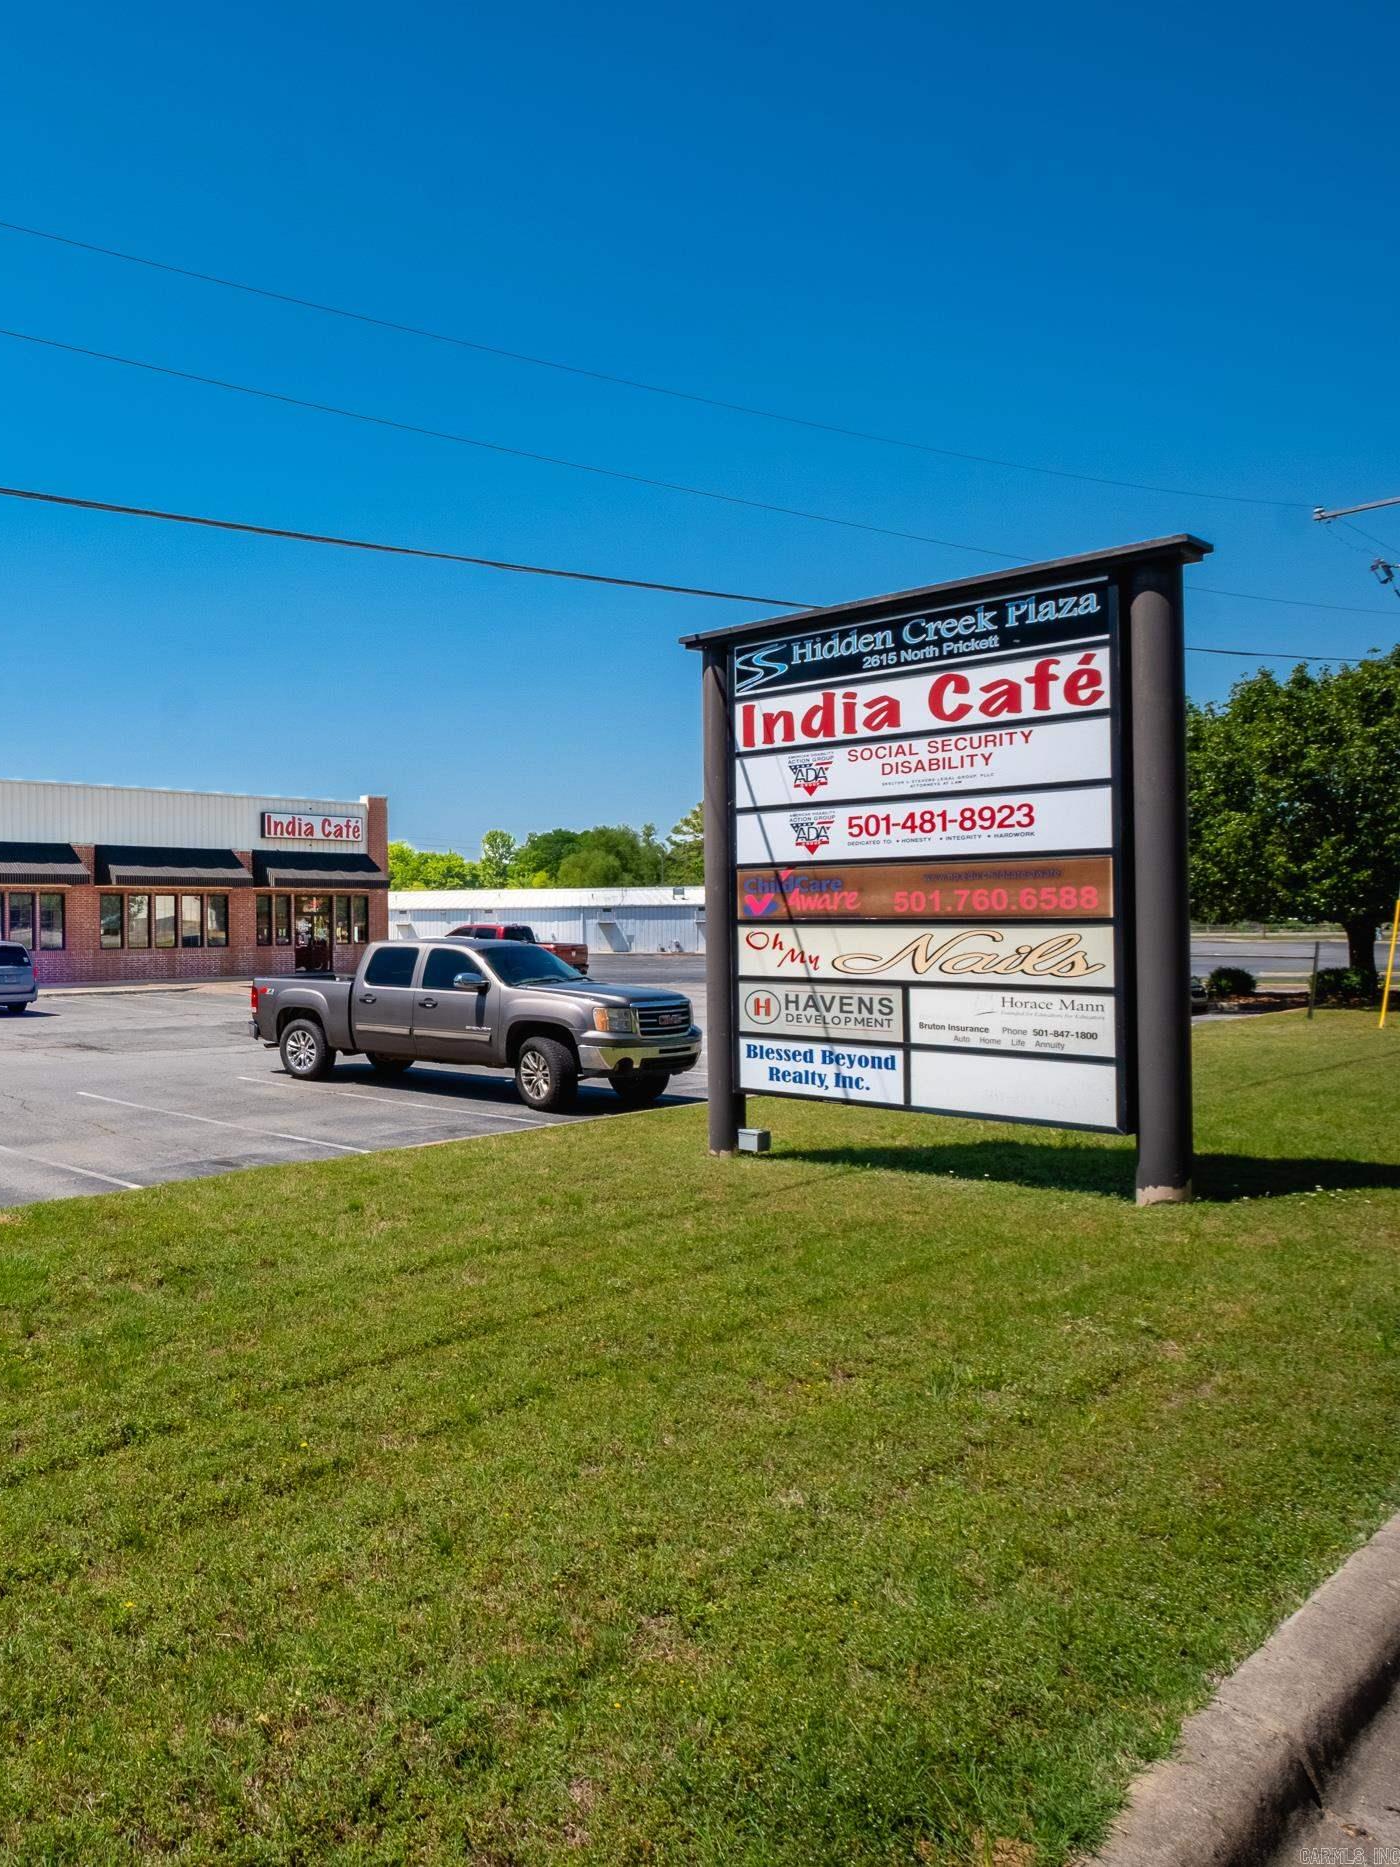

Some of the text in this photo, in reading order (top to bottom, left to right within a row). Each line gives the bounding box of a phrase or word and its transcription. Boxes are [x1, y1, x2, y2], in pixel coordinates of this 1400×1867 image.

[791, 592, 1100, 664] Hidden Creek Plaza
[862, 635, 999, 668] 2615 North Prickett
[743, 653, 1104, 747] India Café
[847, 730, 1033, 762] SOCIAL SECURITY
[794, 767, 828, 783] ADA
[881, 752, 993, 776] DISABILITY
[266, 814, 361, 839] India Café
[848, 803, 1035, 838] 501-481-8923
[795, 826, 829, 841] ADA
[784, 888, 861, 911] Aware
[893, 885, 1098, 913] 501.760.6588
[745, 929, 1105, 977] Oh My Nails
[785, 993, 894, 1016] HAVENS
[1001, 996, 1105, 1013] Horace Mann
[786, 1013, 893, 1028] DEVELOPMENT
[919, 1022, 1098, 1040] Bruton Insurance Phone 501-847-1800
[954, 1035, 1065, 1051] Auto Home Life Annuity
[745, 1044, 896, 1070] Blessed Beyond
[768, 1066, 871, 1091] Realty, Inc.
